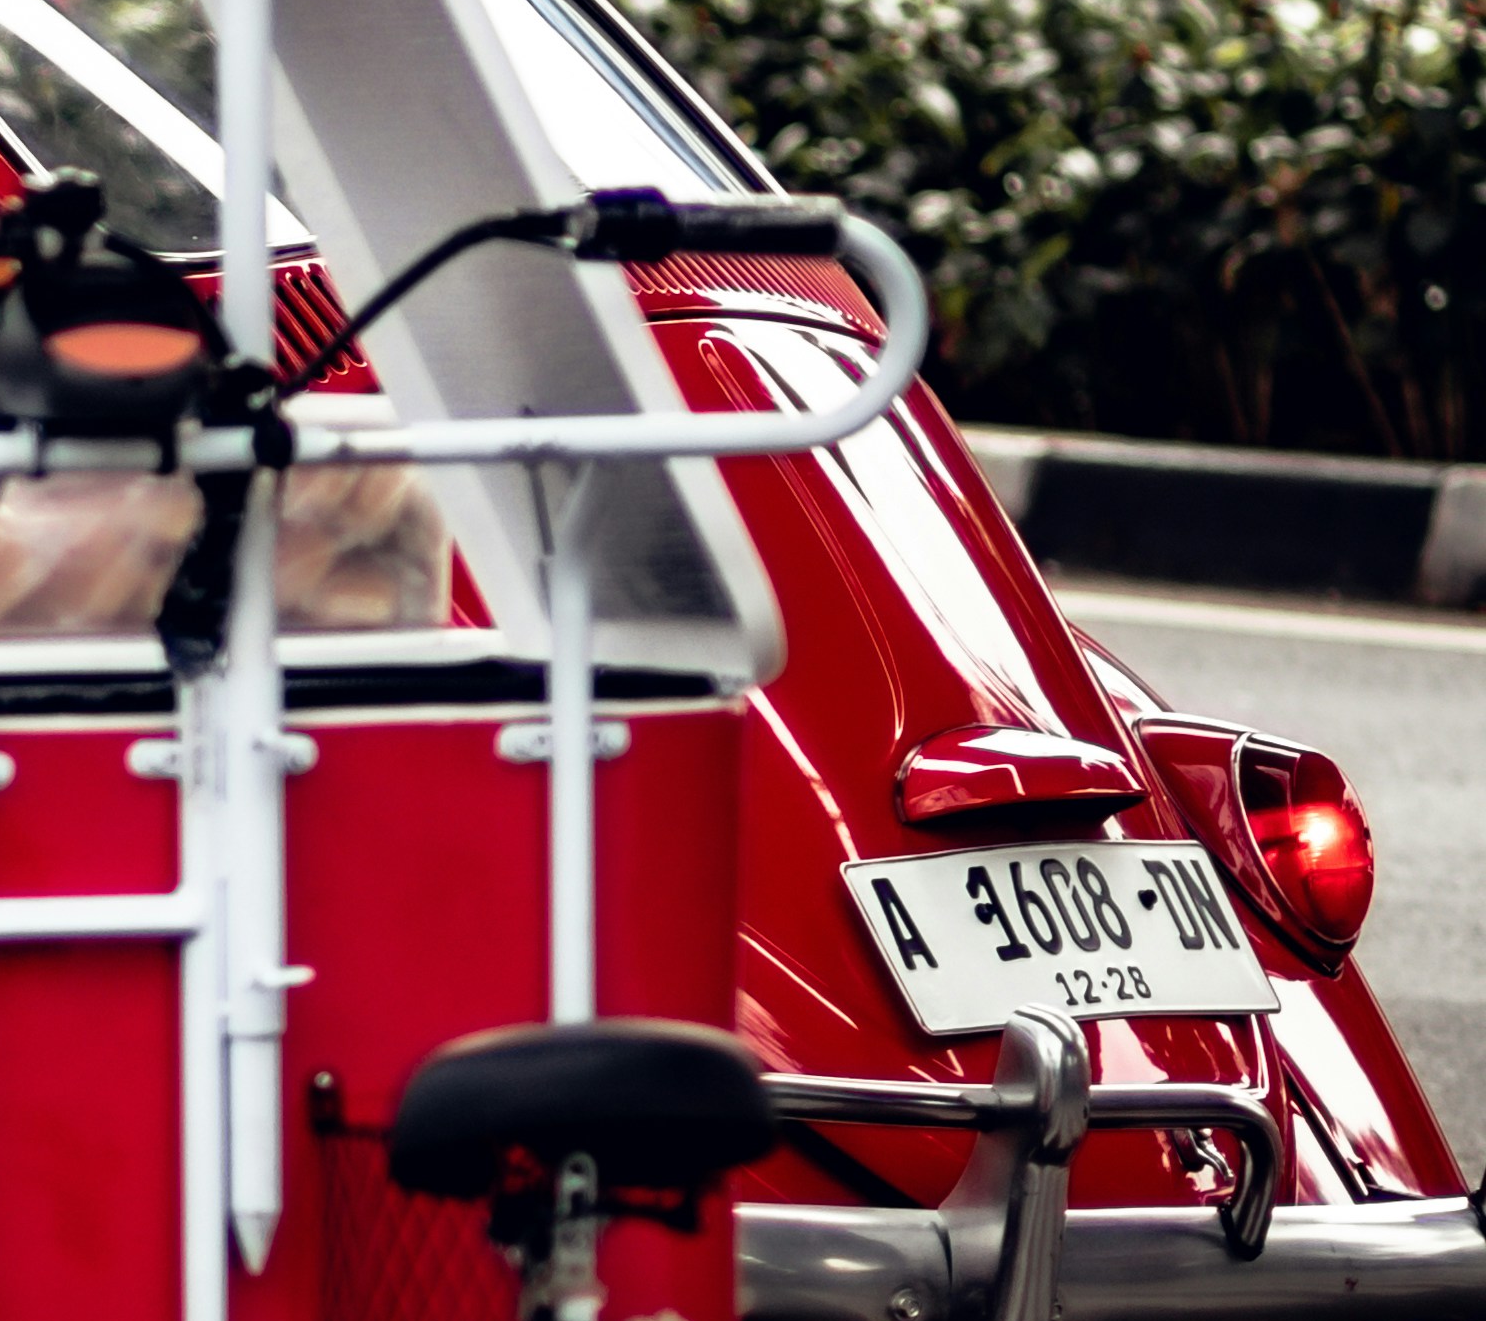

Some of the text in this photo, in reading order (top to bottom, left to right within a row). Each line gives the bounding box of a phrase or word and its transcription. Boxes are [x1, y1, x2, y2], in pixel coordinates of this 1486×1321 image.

[871, 856, 1241, 971] A 1608 DN
